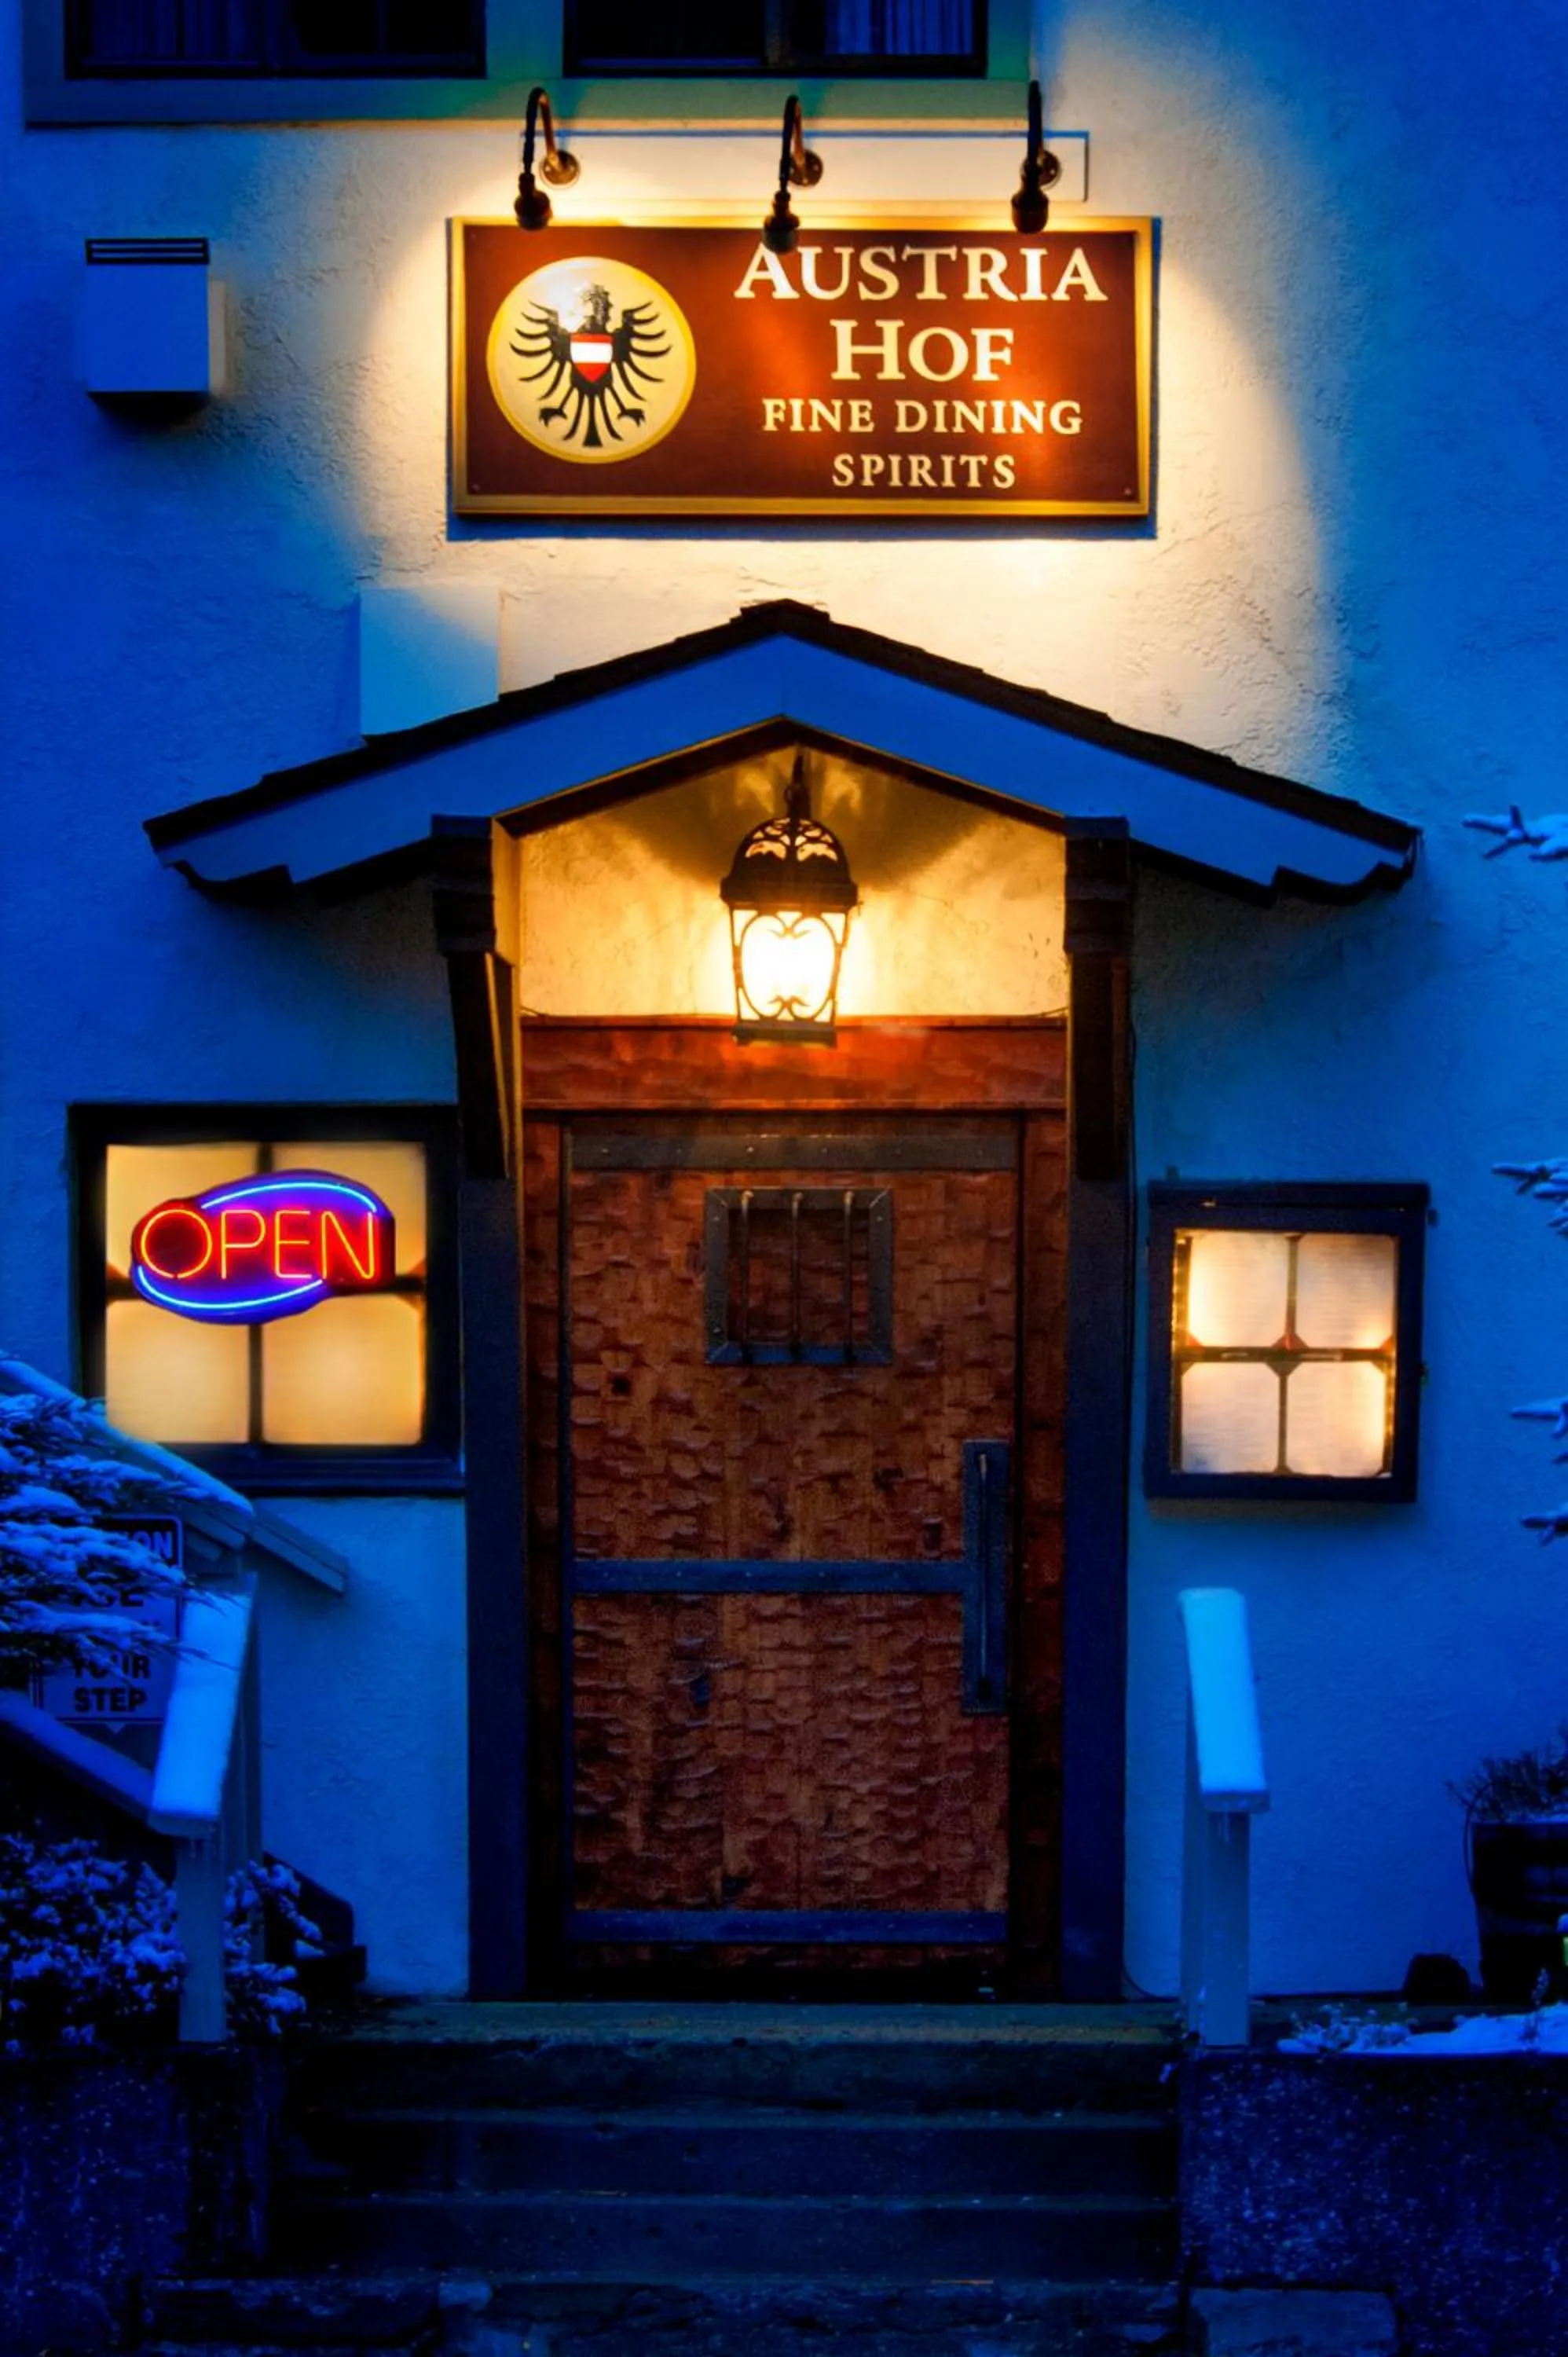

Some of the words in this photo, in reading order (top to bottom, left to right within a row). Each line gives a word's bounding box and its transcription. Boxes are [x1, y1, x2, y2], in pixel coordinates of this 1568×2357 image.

[733, 244, 1108, 302] AUSTRIA
[829, 318, 1014, 382] HOF
[762, 398, 875, 433] FINE
[895, 398, 1083, 434] DINING
[832, 453, 1016, 489] SPIRITS
[139, 1208, 376, 1281] OPEN
[74, 1687, 147, 1712] STEP
